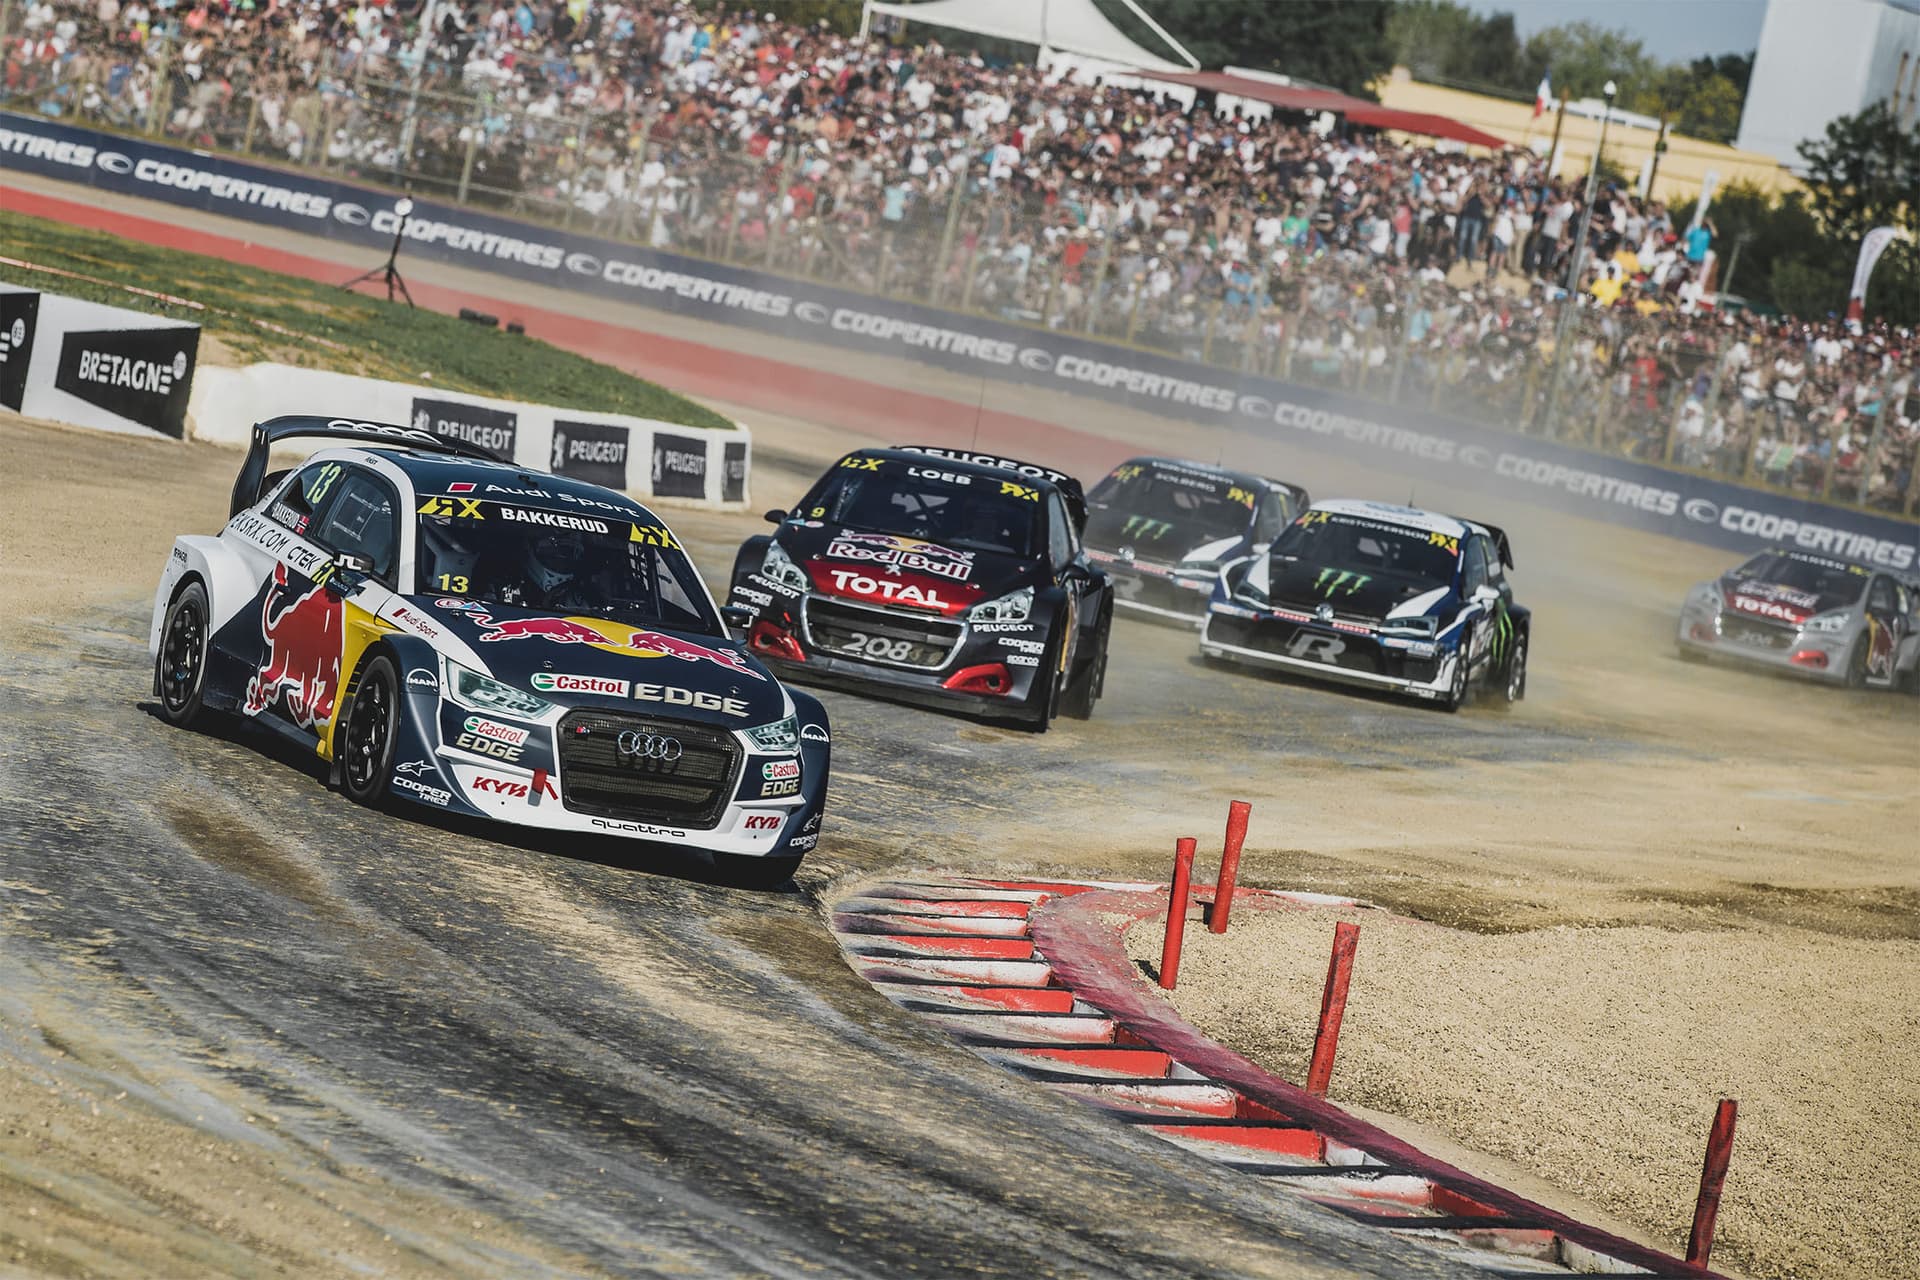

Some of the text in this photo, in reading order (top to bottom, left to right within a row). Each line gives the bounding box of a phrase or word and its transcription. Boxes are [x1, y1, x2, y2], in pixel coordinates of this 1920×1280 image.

[78, 350, 173, 394] BRETAGNE
[438, 419, 513, 450] PEUGEOT
[569, 440, 626, 463] PEUGEOT
[665, 450, 705, 475] PEUGEOT
[306, 462, 341, 504] 13
[908, 467, 972, 485] LOEB
[485, 484, 640, 518] Audi Sport
[811, 507, 826, 518] 9
[500, 507, 609, 534] BAKKERUD
[287, 546, 321, 571] CTEK
[827, 541, 972, 582] Red Bull
[438, 574, 470, 593] 13
[748, 574, 800, 599] PEUGEOT
[831, 569, 949, 609] TOTAL
[1735, 596, 1797, 622] TOTAL
[401, 611, 439, 639] Audi Sport
[973, 624, 1034, 632] PEUGEOT
[843, 632, 912, 660] 208
[408, 678, 437, 687] MAN
[556, 675, 750, 718] Castrol EDGE
[477, 720, 524, 744] Castrol
[802, 731, 829, 743] MAN
[456, 732, 525, 762] EDGE
[772, 762, 799, 778] Castrol
[392, 776, 452, 800] COOPER
[473, 776, 528, 798] KYB
[760, 779, 799, 796] EDGE
[418, 793, 449, 807] TIRES
[591, 819, 686, 838] quattro
[744, 816, 780, 829] KYB
